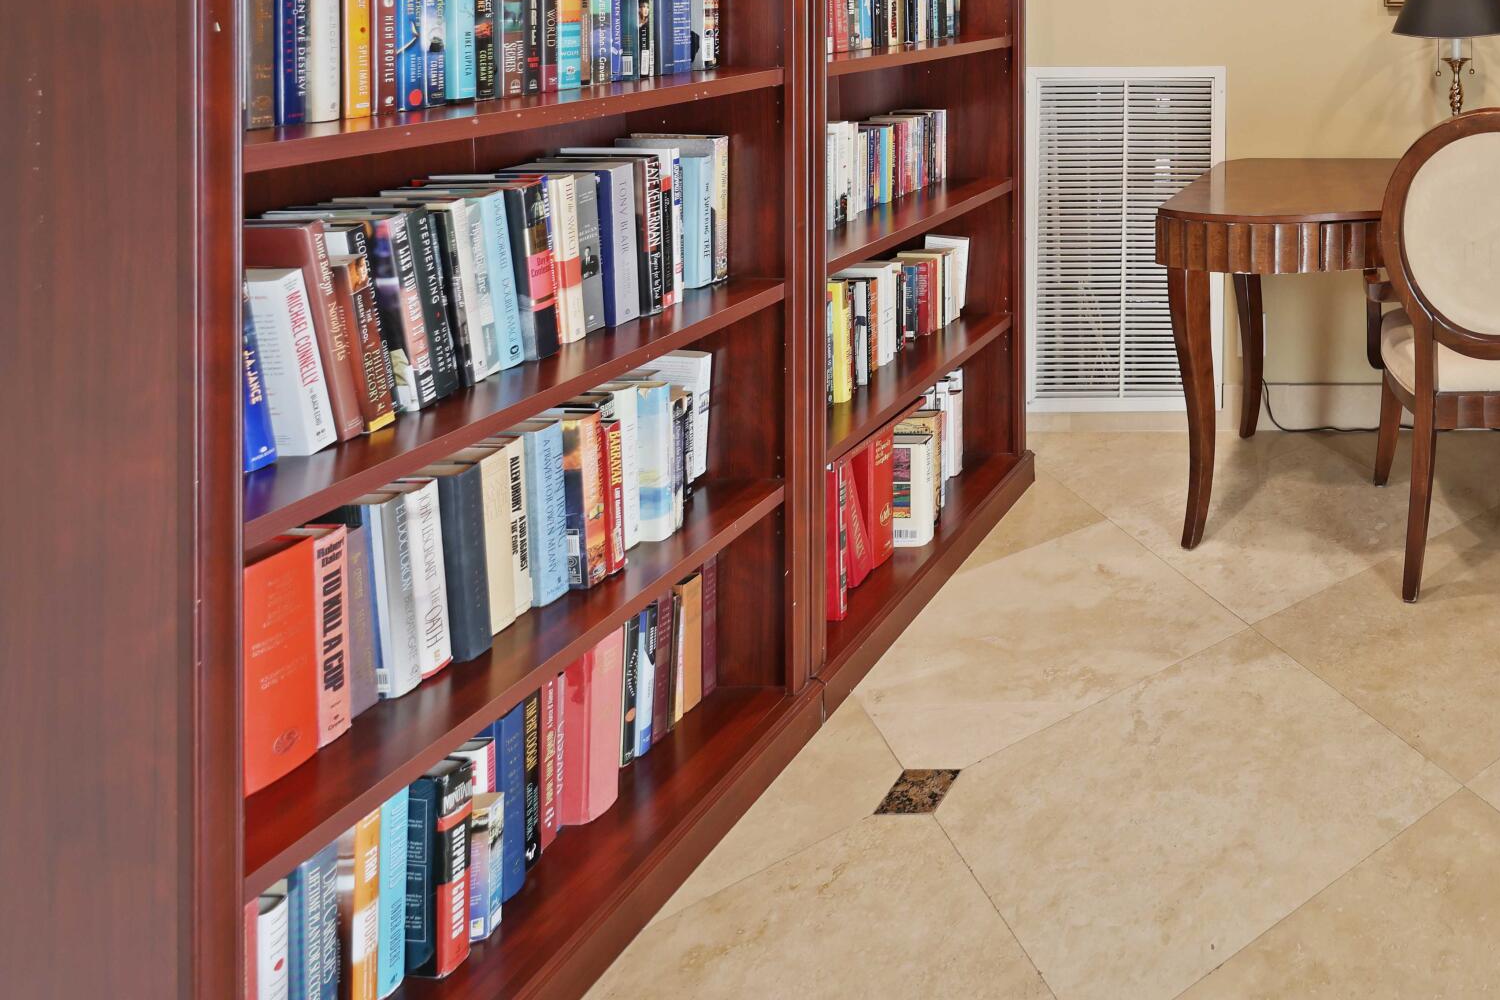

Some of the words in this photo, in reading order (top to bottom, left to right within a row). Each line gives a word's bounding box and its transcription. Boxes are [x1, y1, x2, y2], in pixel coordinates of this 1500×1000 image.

[297, 25, 306, 42] WE
[384, 15, 394, 39] HIGH
[546, 11, 556, 48] WORLD
[599, 28, 607, 46] John
[296, 46, 306, 97] DESERVE
[359, 44, 368, 67] SPLIT
[384, 43, 394, 84] PROFILE
[598, 56, 607, 82] Graves
[359, 69, 368, 96] IMAGE
[646, 160, 659, 186] FAYE
[618, 181, 628, 216] TONY
[647, 187, 661, 247] KELLERMAN
[313, 232, 327, 259] Anne
[619, 220, 630, 254] BLAIR
[418, 217, 436, 272] STEPHEN
[427, 273, 440, 305] KING
[317, 260, 335, 296] Boleyn
[286, 289, 306, 337] MICHAEL
[327, 301, 344, 333] Norah
[332, 334, 347, 362] Lofts
[433, 329, 441, 343] NO
[294, 338, 319, 389] CONNELLY
[370, 348, 387, 398] PHILIPPA
[436, 346, 445, 372] STARS
[362, 352, 379, 404] GREGORY
[510, 456, 521, 485] ALLEN
[608, 430, 623, 486] BARRAYAR
[511, 484, 522, 514] DRURY
[526, 697, 537, 719] TIM
[526, 716, 537, 735] PAT
[526, 731, 537, 772] COOGAN
[364, 845, 378, 884] FIRM
[451, 823, 465, 884] STEPHEN
[308, 866, 321, 916] LIFETIME
[451, 881, 465, 940] COONTS
[308, 914, 321, 942] PLAN
[308, 938, 321, 963] FOR
